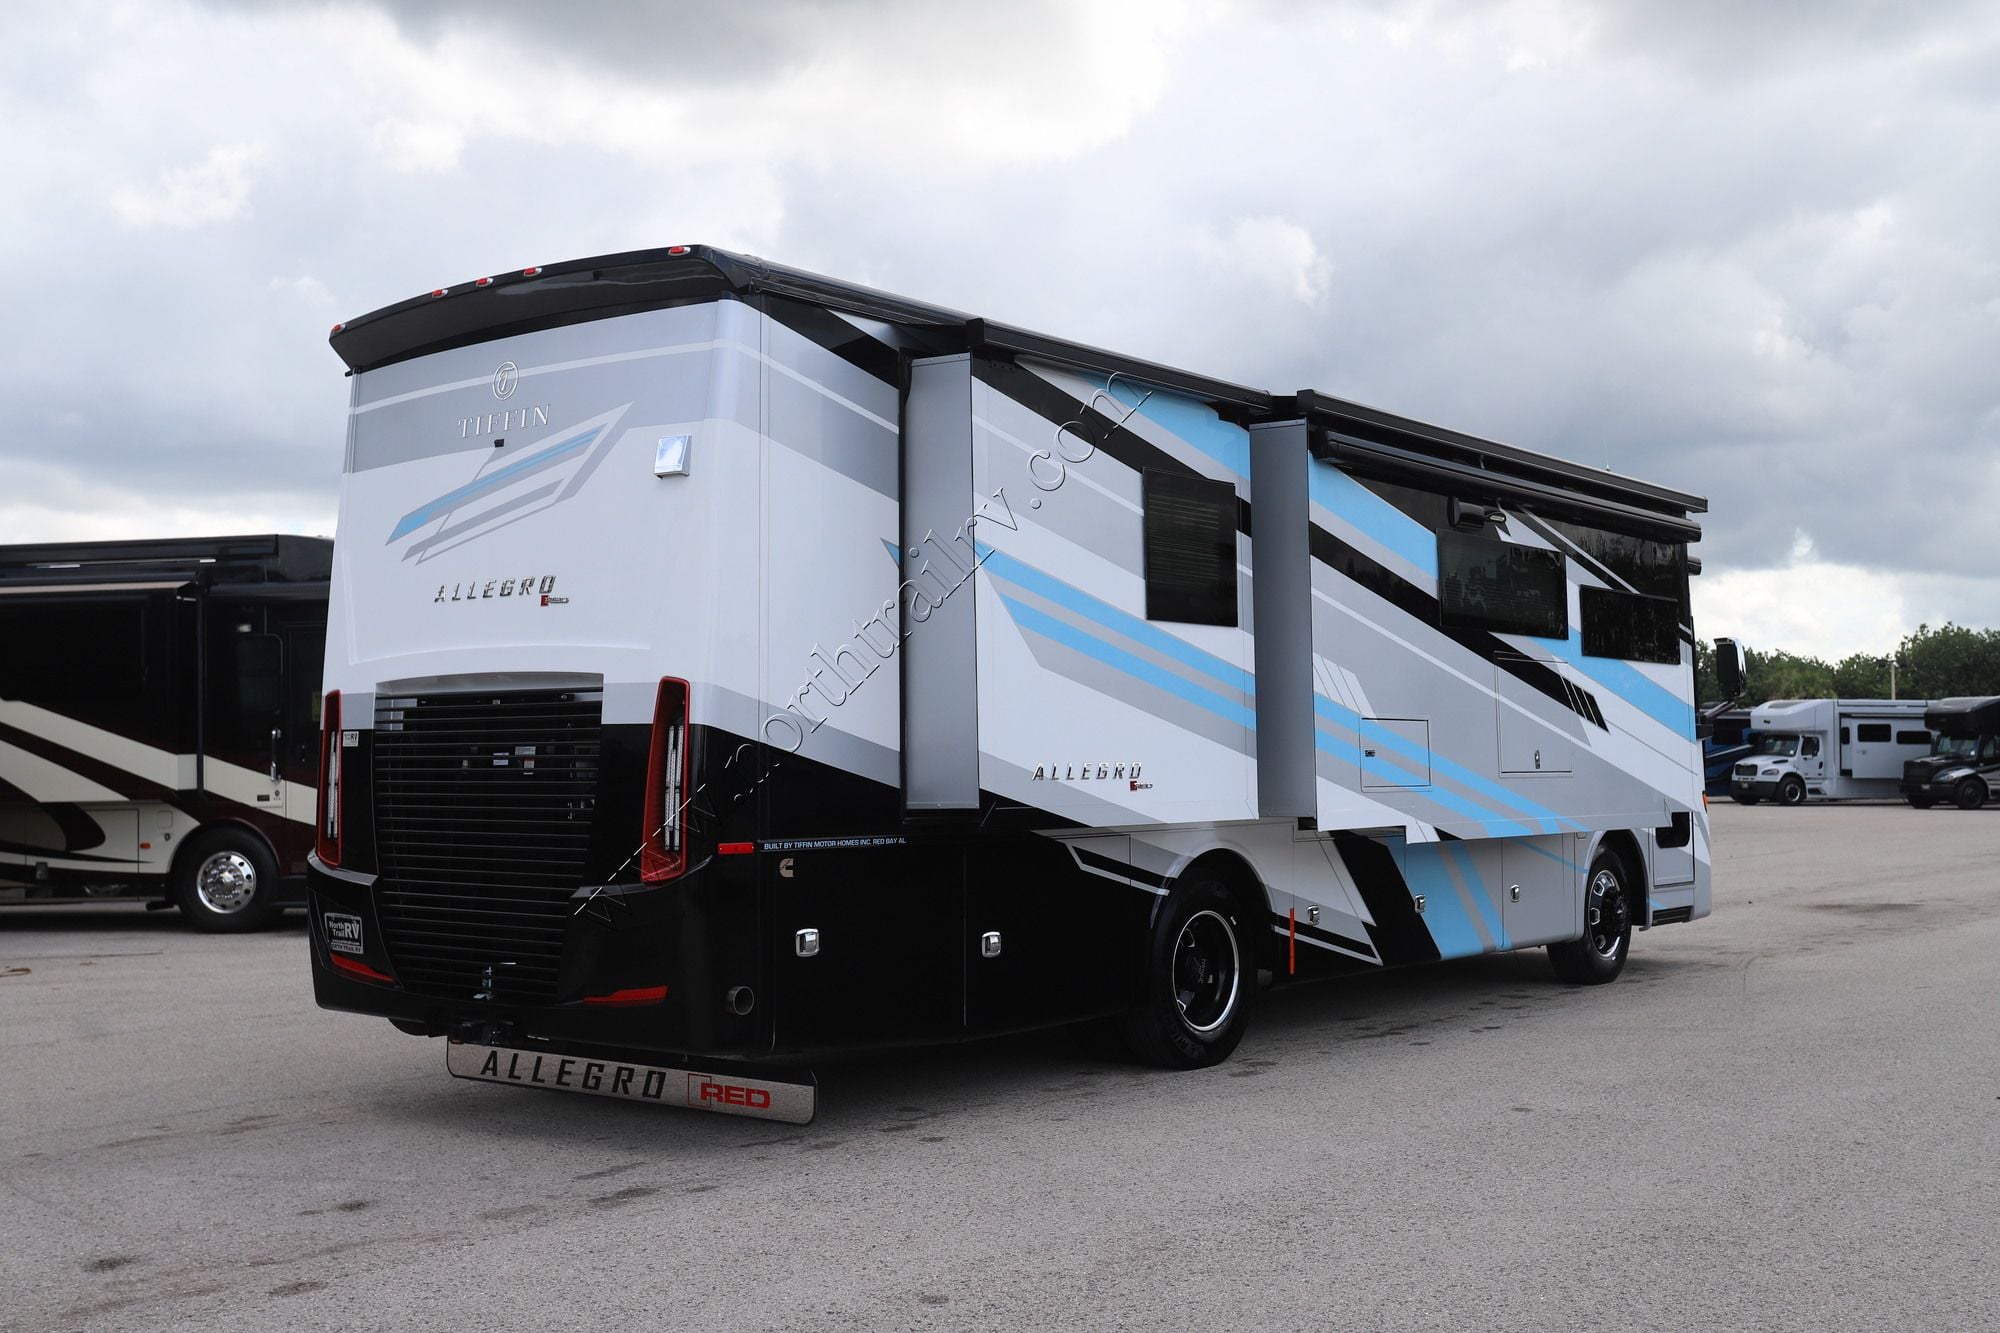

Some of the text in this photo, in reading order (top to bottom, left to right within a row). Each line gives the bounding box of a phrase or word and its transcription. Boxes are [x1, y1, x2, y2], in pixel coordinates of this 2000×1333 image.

[458, 403, 551, 438] TIFFIN
[433, 575, 556, 603] ALLEGRO
[1031, 761, 1142, 781] ALLEGRO
[764, 842, 783, 850] BUILT
[793, 841, 814, 849] TIFFIN
[814, 840, 837, 848] MOTOR
[837, 839, 860, 847] HOMES
[872, 837, 885, 845] RED
[329, 921, 344, 929] North
[344, 922, 359, 939] RV
[480, 1050, 771, 1109] ALLEGRO RED
